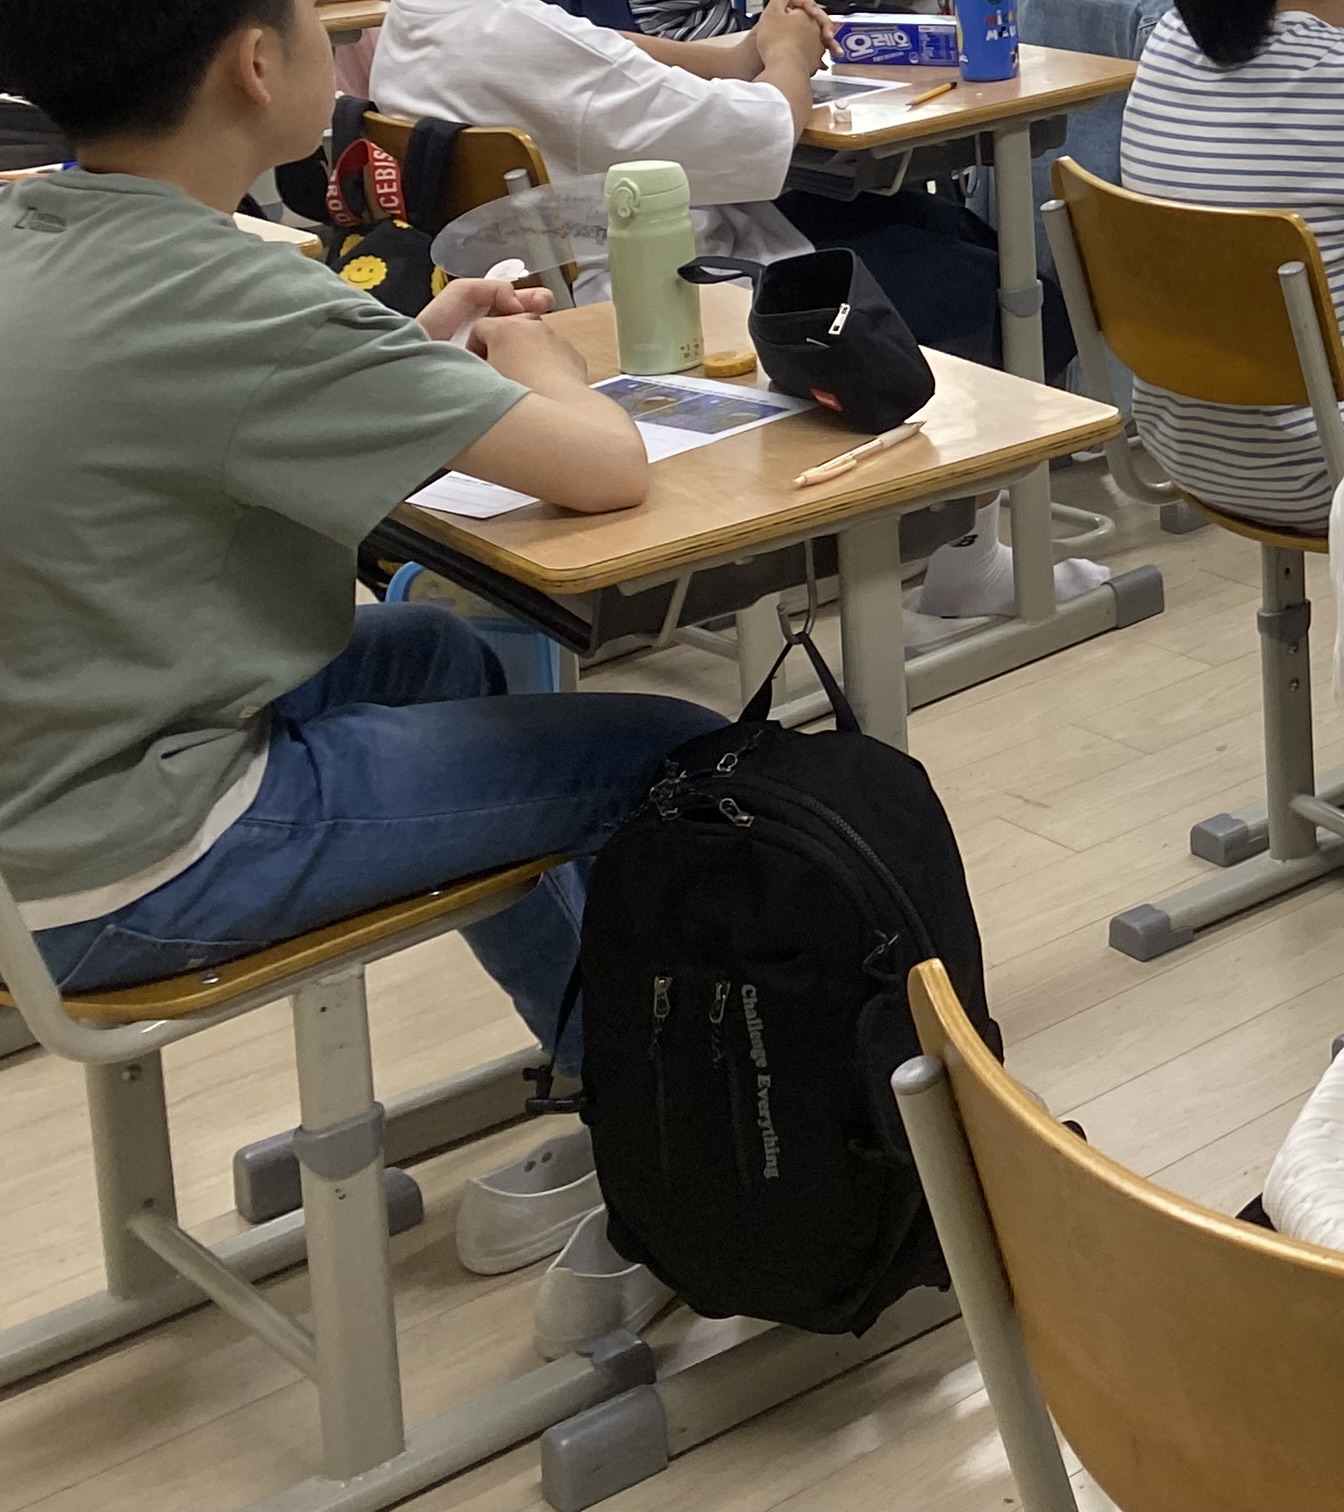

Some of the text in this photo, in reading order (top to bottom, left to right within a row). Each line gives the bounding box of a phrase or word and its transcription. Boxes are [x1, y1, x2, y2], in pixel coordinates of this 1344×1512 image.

[845, 30, 911, 58] 오레오
[741, 983, 781, 1180] Challenge Everything
